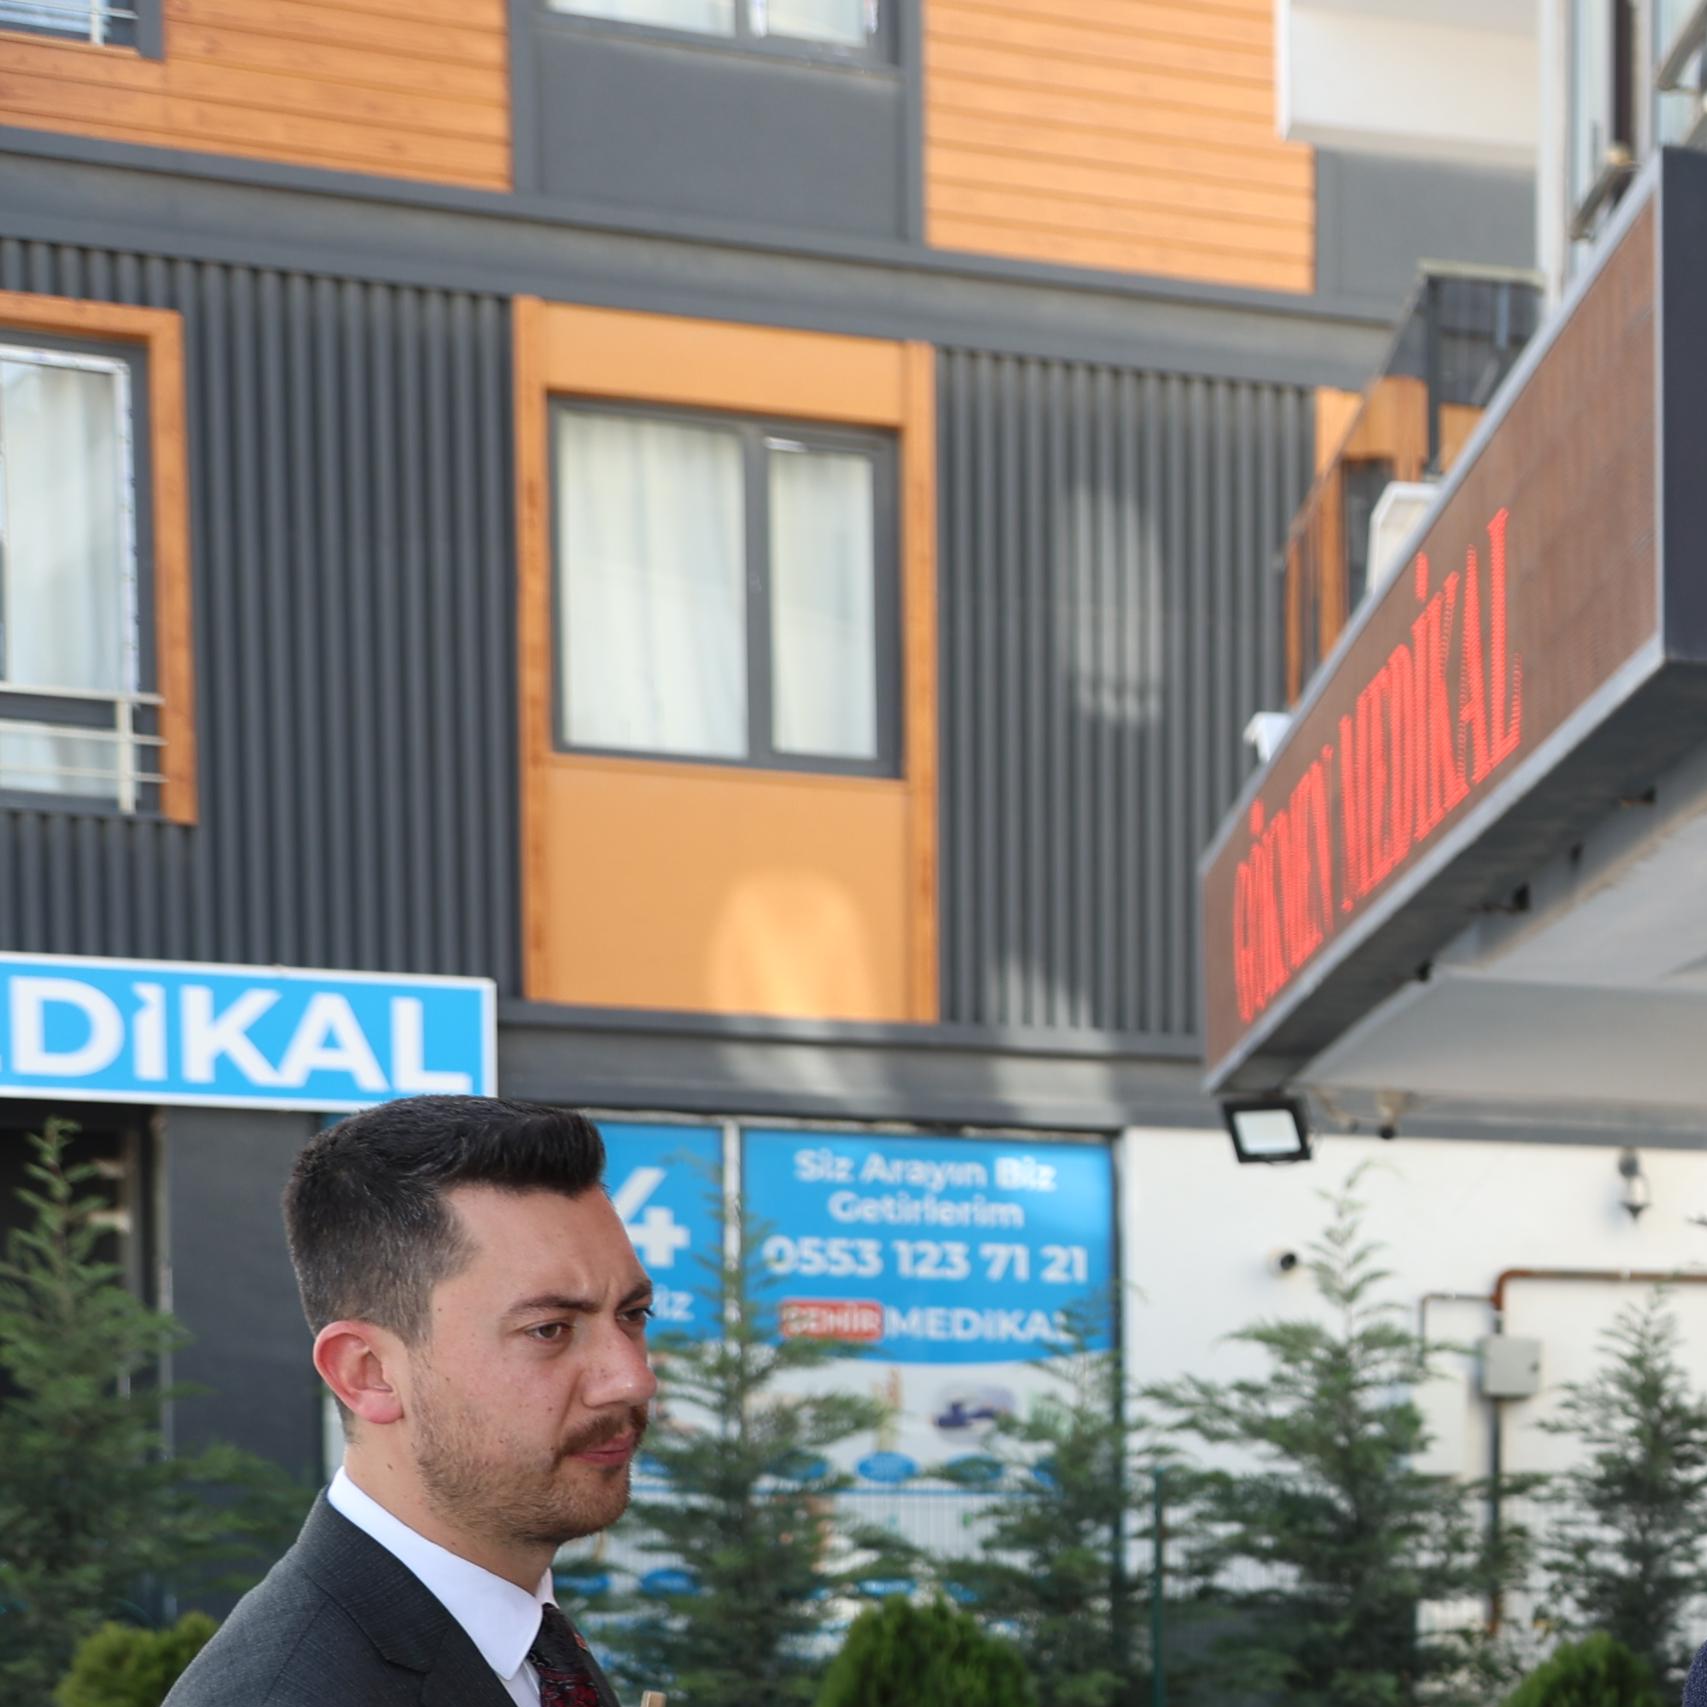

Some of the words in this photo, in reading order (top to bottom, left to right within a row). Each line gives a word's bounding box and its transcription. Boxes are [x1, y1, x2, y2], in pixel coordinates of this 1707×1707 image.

[1339, 507, 1523, 913] MEDİKAL
[0, 975, 472, 1092] DİKAL
[794, 1149, 854, 1184] Siz
[859, 1151, 987, 1192] Arayın
[994, 1156, 1057, 1192] Biz
[761, 1234, 883, 1278] 0553
[892, 1240, 970, 1280] 123
[980, 1244, 1031, 1282] 71
[1041, 1246, 1088, 1284] 21
